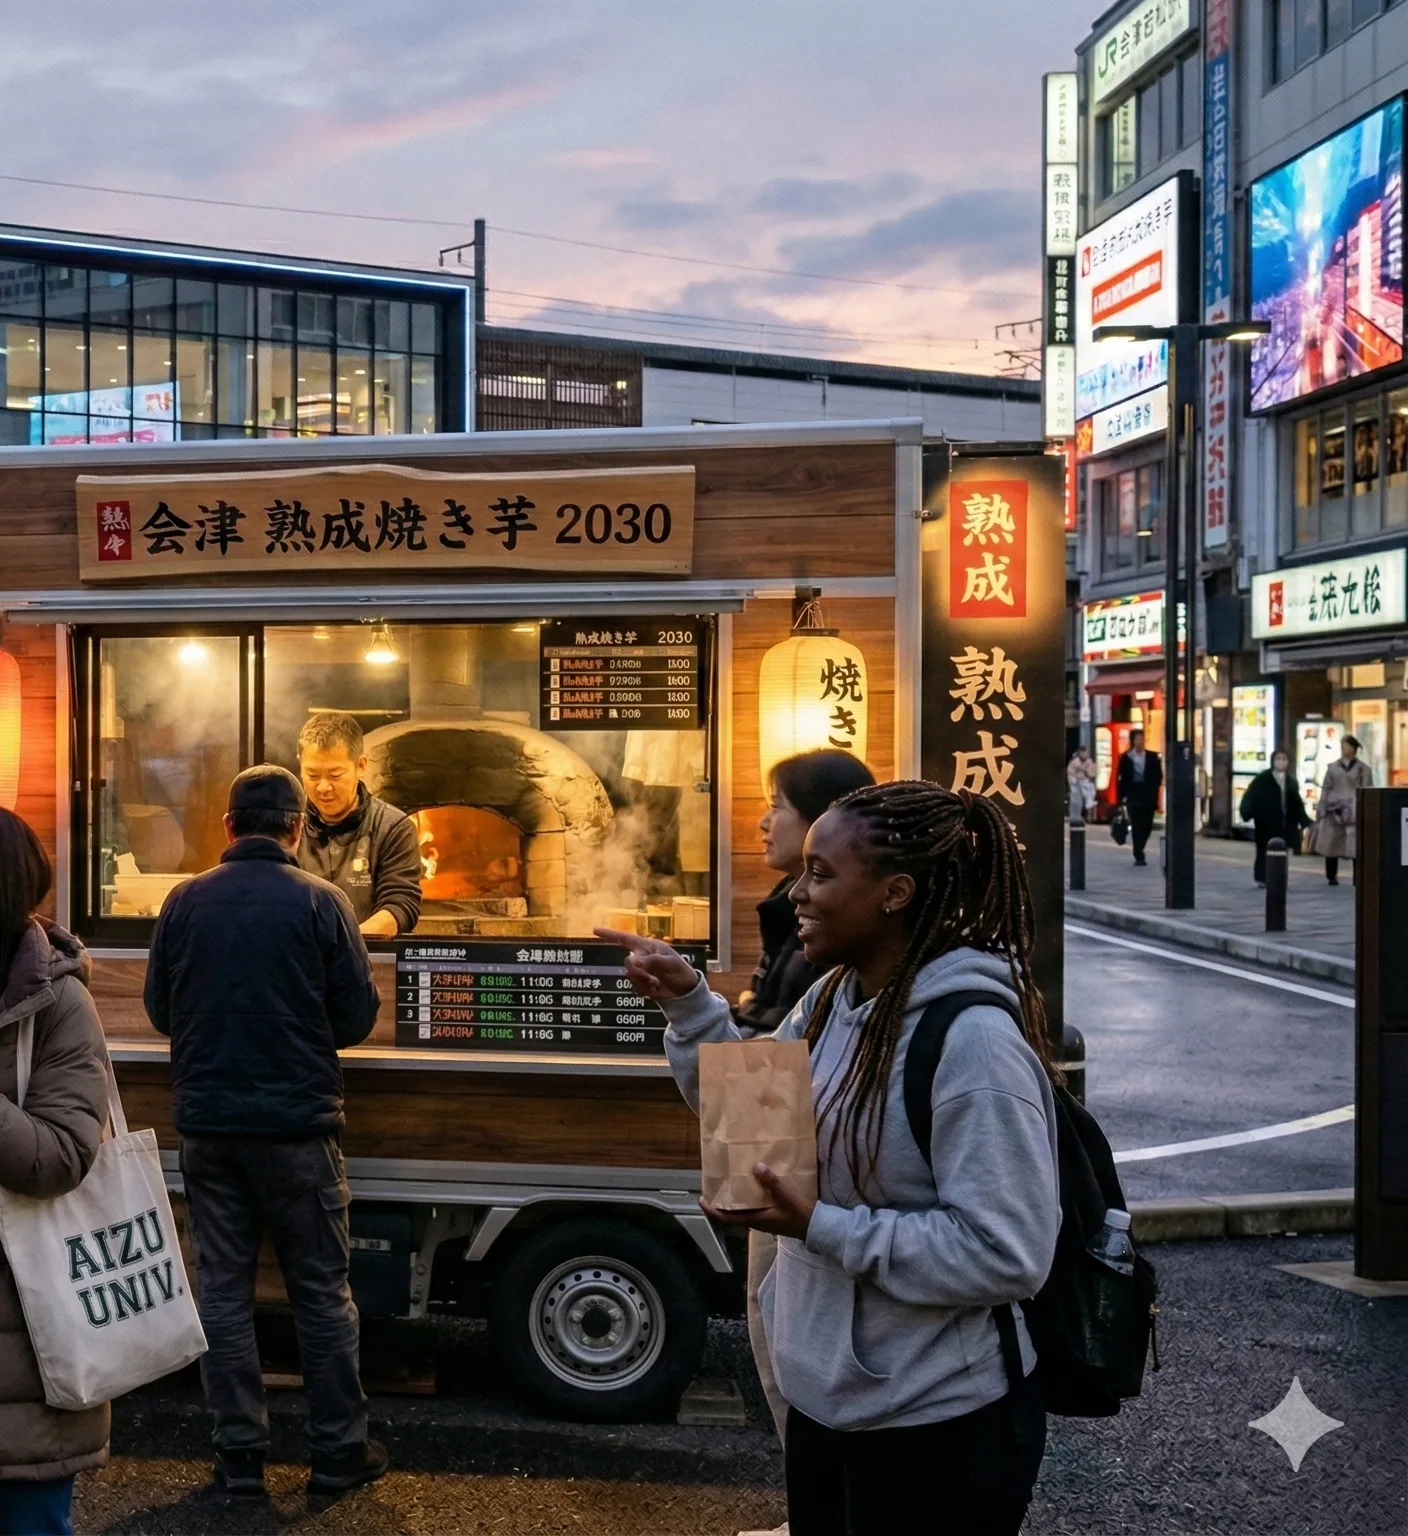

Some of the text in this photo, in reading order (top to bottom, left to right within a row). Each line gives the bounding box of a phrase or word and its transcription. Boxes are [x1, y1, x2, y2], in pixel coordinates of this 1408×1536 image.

[138, 495, 673, 556] 会津 熟成焼き芋 2030
[961, 493, 1017, 607] 熟成
[657, 630, 693, 644] 2030
[819, 656, 863, 749] 焼き
[64, 1206, 166, 1284] AIZU
[76, 1257, 184, 1329] UNIV.
